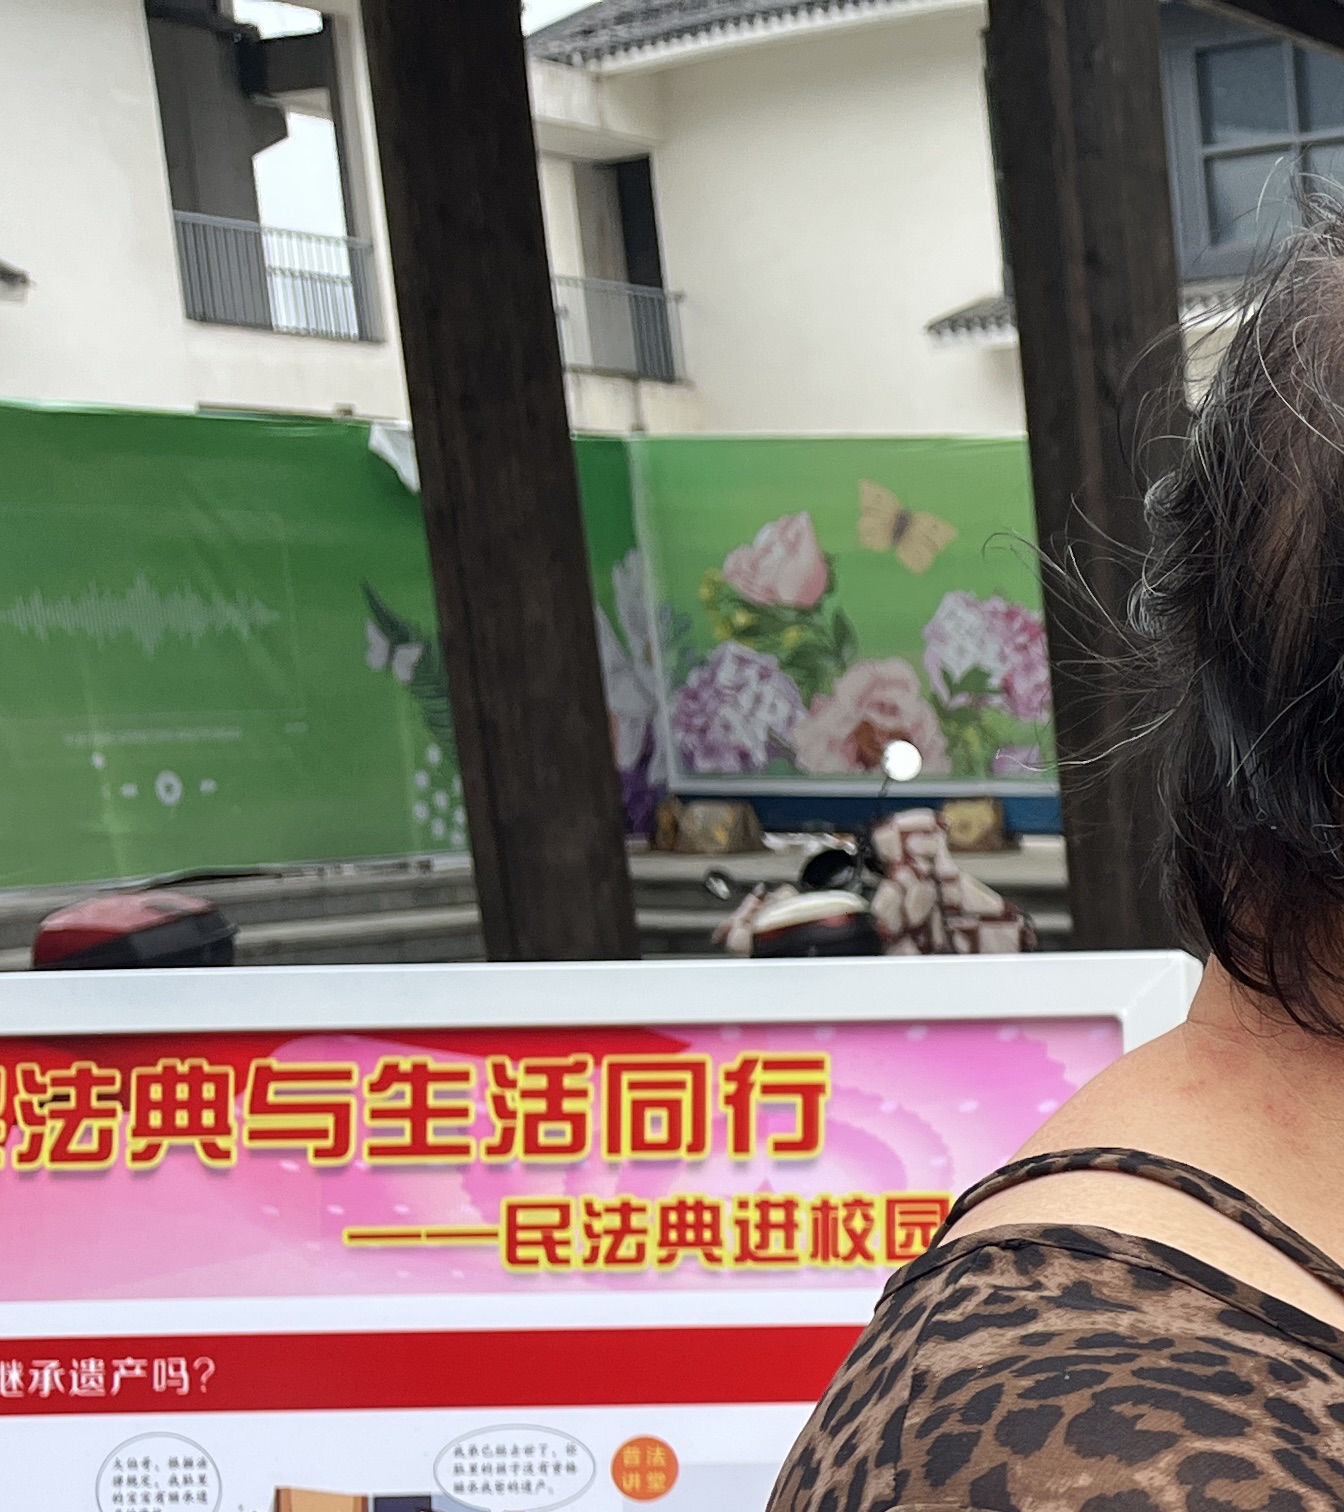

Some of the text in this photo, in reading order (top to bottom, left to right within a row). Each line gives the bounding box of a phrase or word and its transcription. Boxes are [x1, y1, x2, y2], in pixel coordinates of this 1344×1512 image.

[0, 1050, 831, 1168] 法典与生活同行
[622, 1444, 666, 1467] 普法
[622, 1471, 667, 1492] 讲堂
